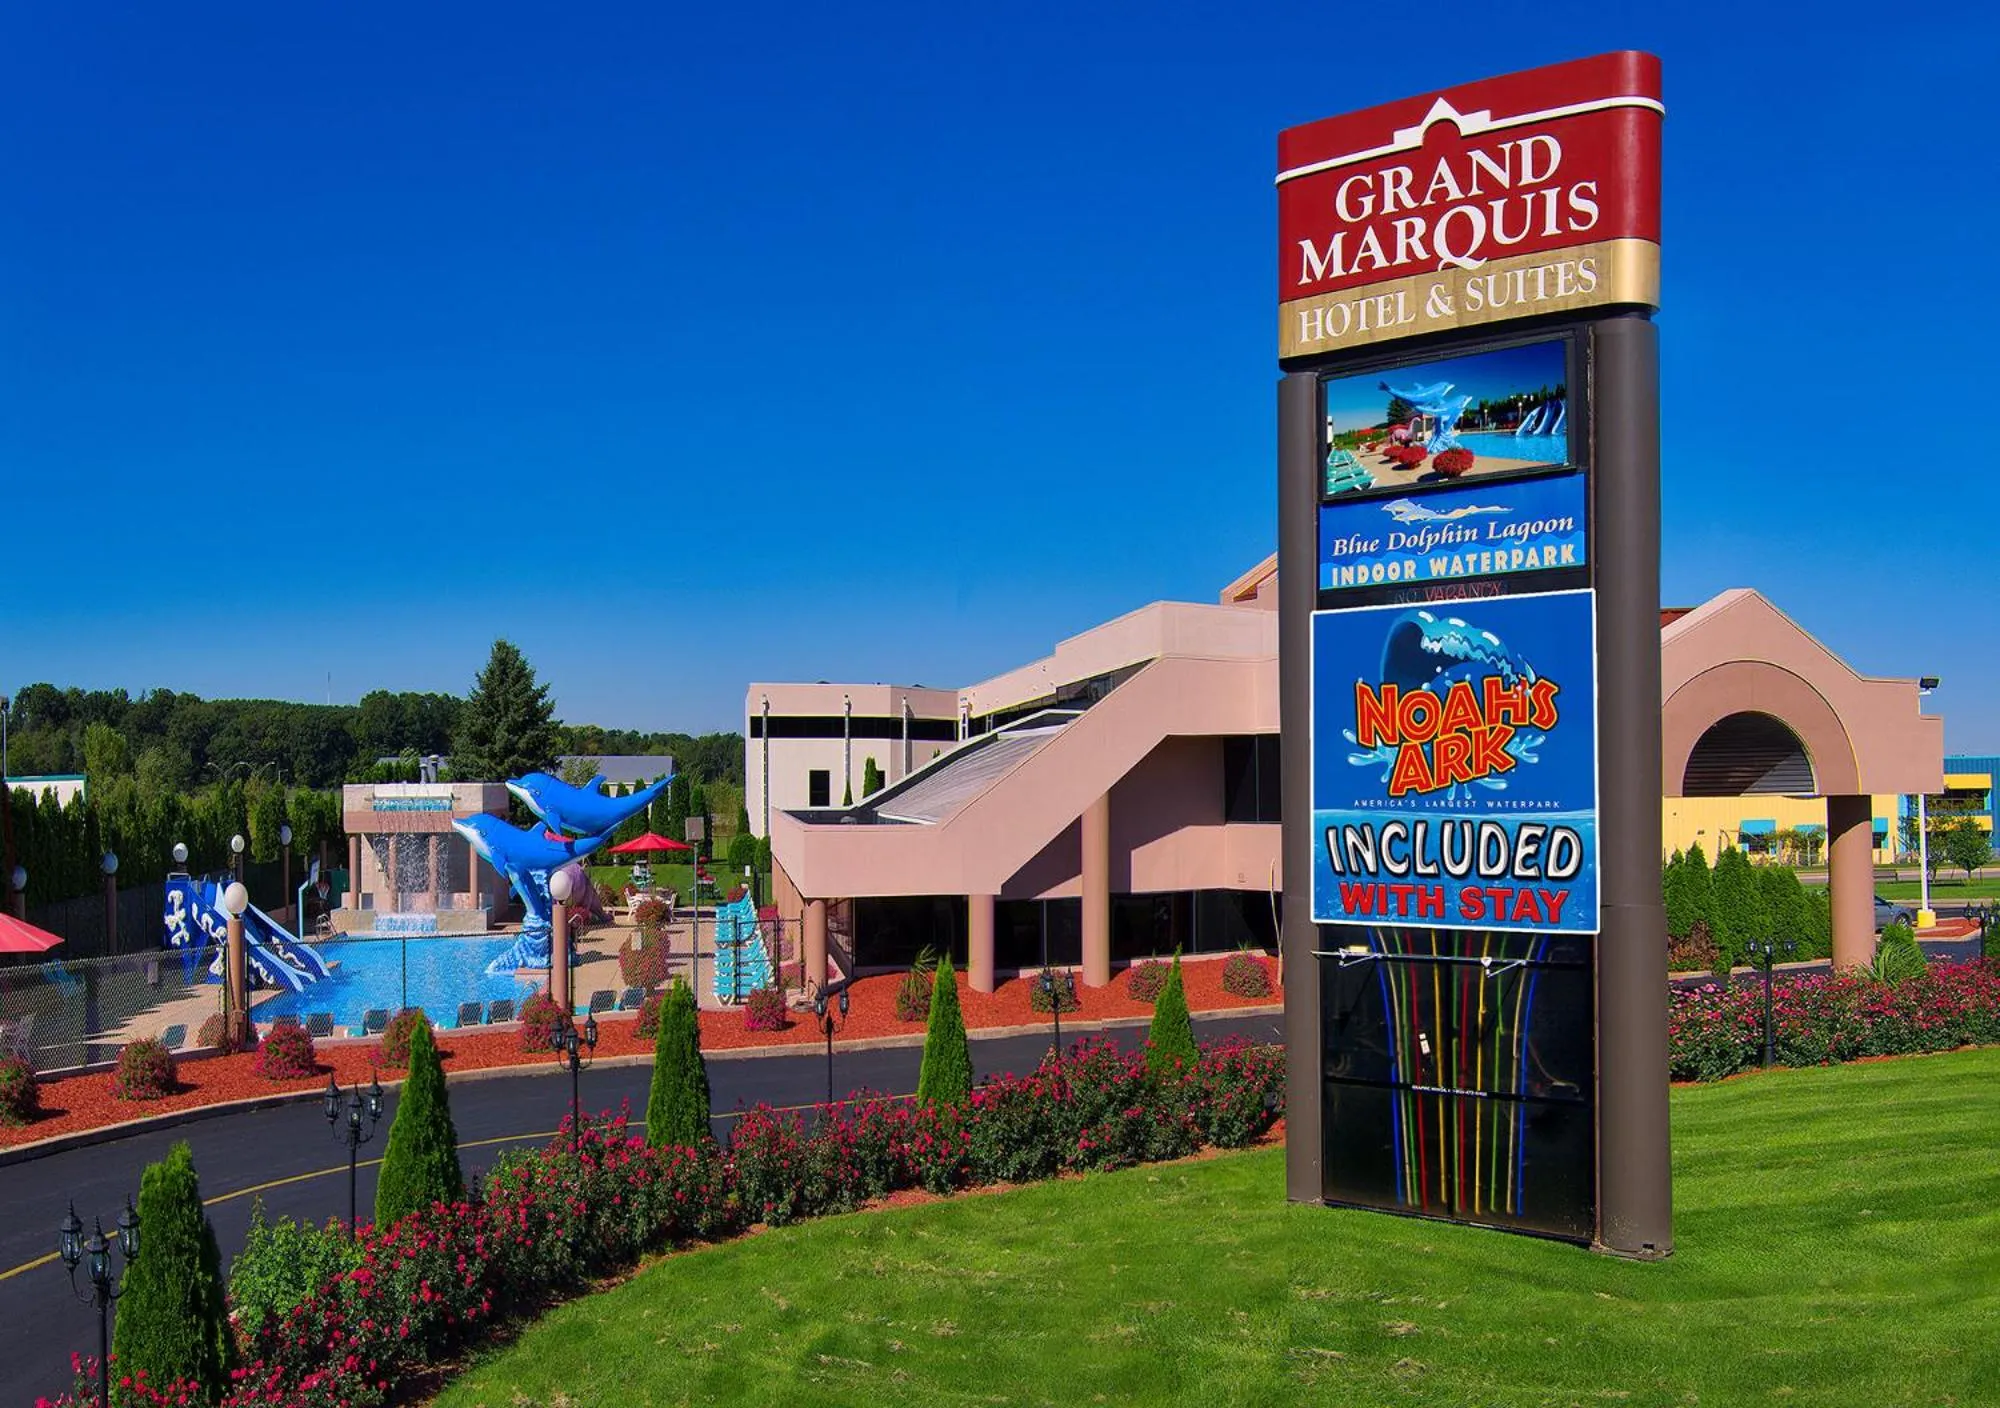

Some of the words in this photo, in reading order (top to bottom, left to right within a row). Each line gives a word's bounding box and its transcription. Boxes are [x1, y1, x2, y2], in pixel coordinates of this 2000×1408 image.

[1335, 134, 1562, 223] GRAND
[1298, 180, 1600, 286] MARQUIS
[1298, 291, 1416, 343] HOTEL
[1425, 283, 1456, 320] &
[1465, 257, 1598, 312] SUITES
[1331, 533, 1380, 557] Blue
[1387, 523, 1479, 556] Dolphin
[1486, 515, 1574, 545] Lagoon
[1331, 558, 1417, 587] INDOOR
[1429, 543, 1577, 578] WATERPARK
[1424, 581, 1501, 603] VACANCY
[1388, 723, 1517, 797] ARK
[1353, 798, 1417, 809] AMERICA'S
[1425, 799, 1478, 809] LARGEST
[1487, 799, 1561, 810] WATERPARK
[1326, 821, 1582, 879] INCLUDED
[1339, 881, 1445, 919] WITH
[1459, 885, 1570, 924] STAY
